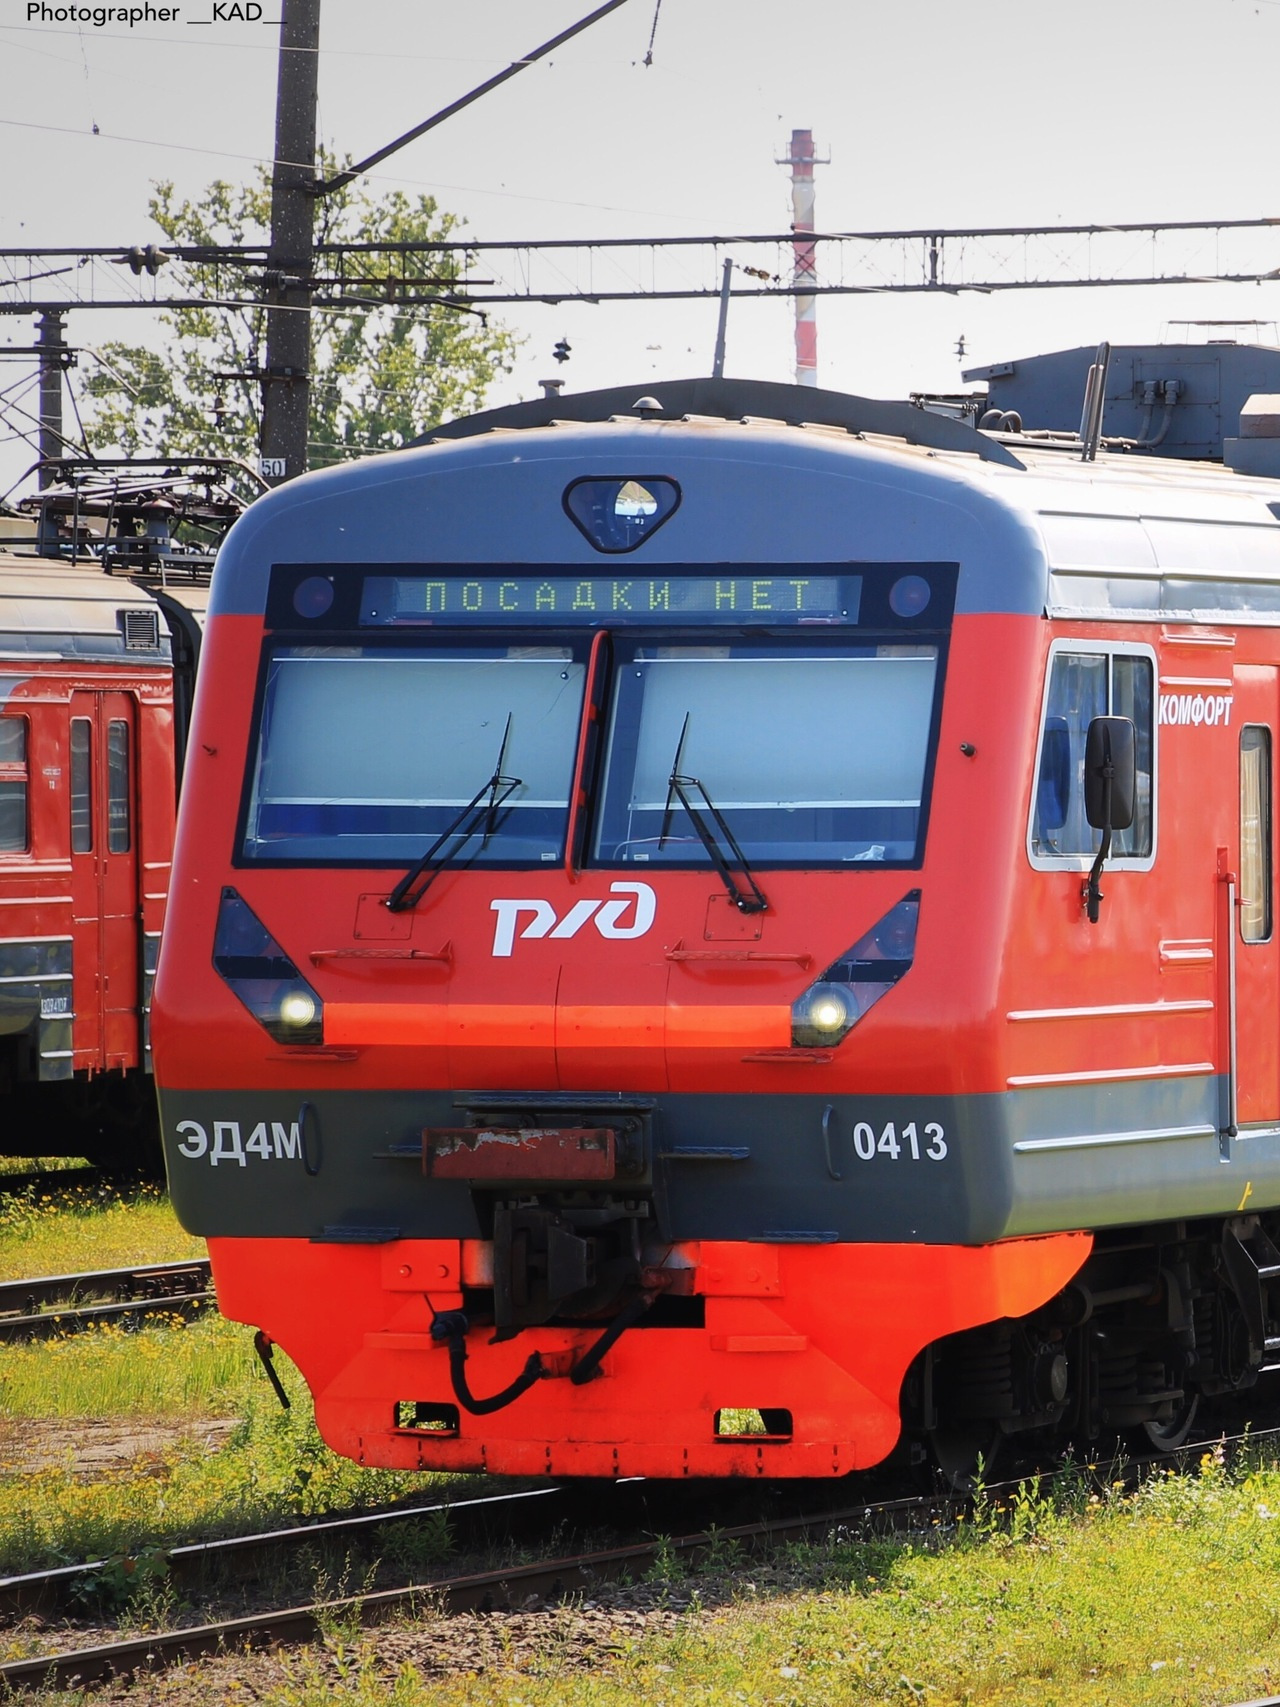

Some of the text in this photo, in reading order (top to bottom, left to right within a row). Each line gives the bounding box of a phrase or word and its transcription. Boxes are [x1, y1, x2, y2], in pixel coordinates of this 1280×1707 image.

[262, 461, 282, 476] 50
[426, 580, 809, 610] ПОСАДКИ НЕТ
[1159, 694, 1233, 726] КОМФОРТ
[175, 1120, 302, 1167] ЭД4М
[853, 1122, 948, 1161] 0413
